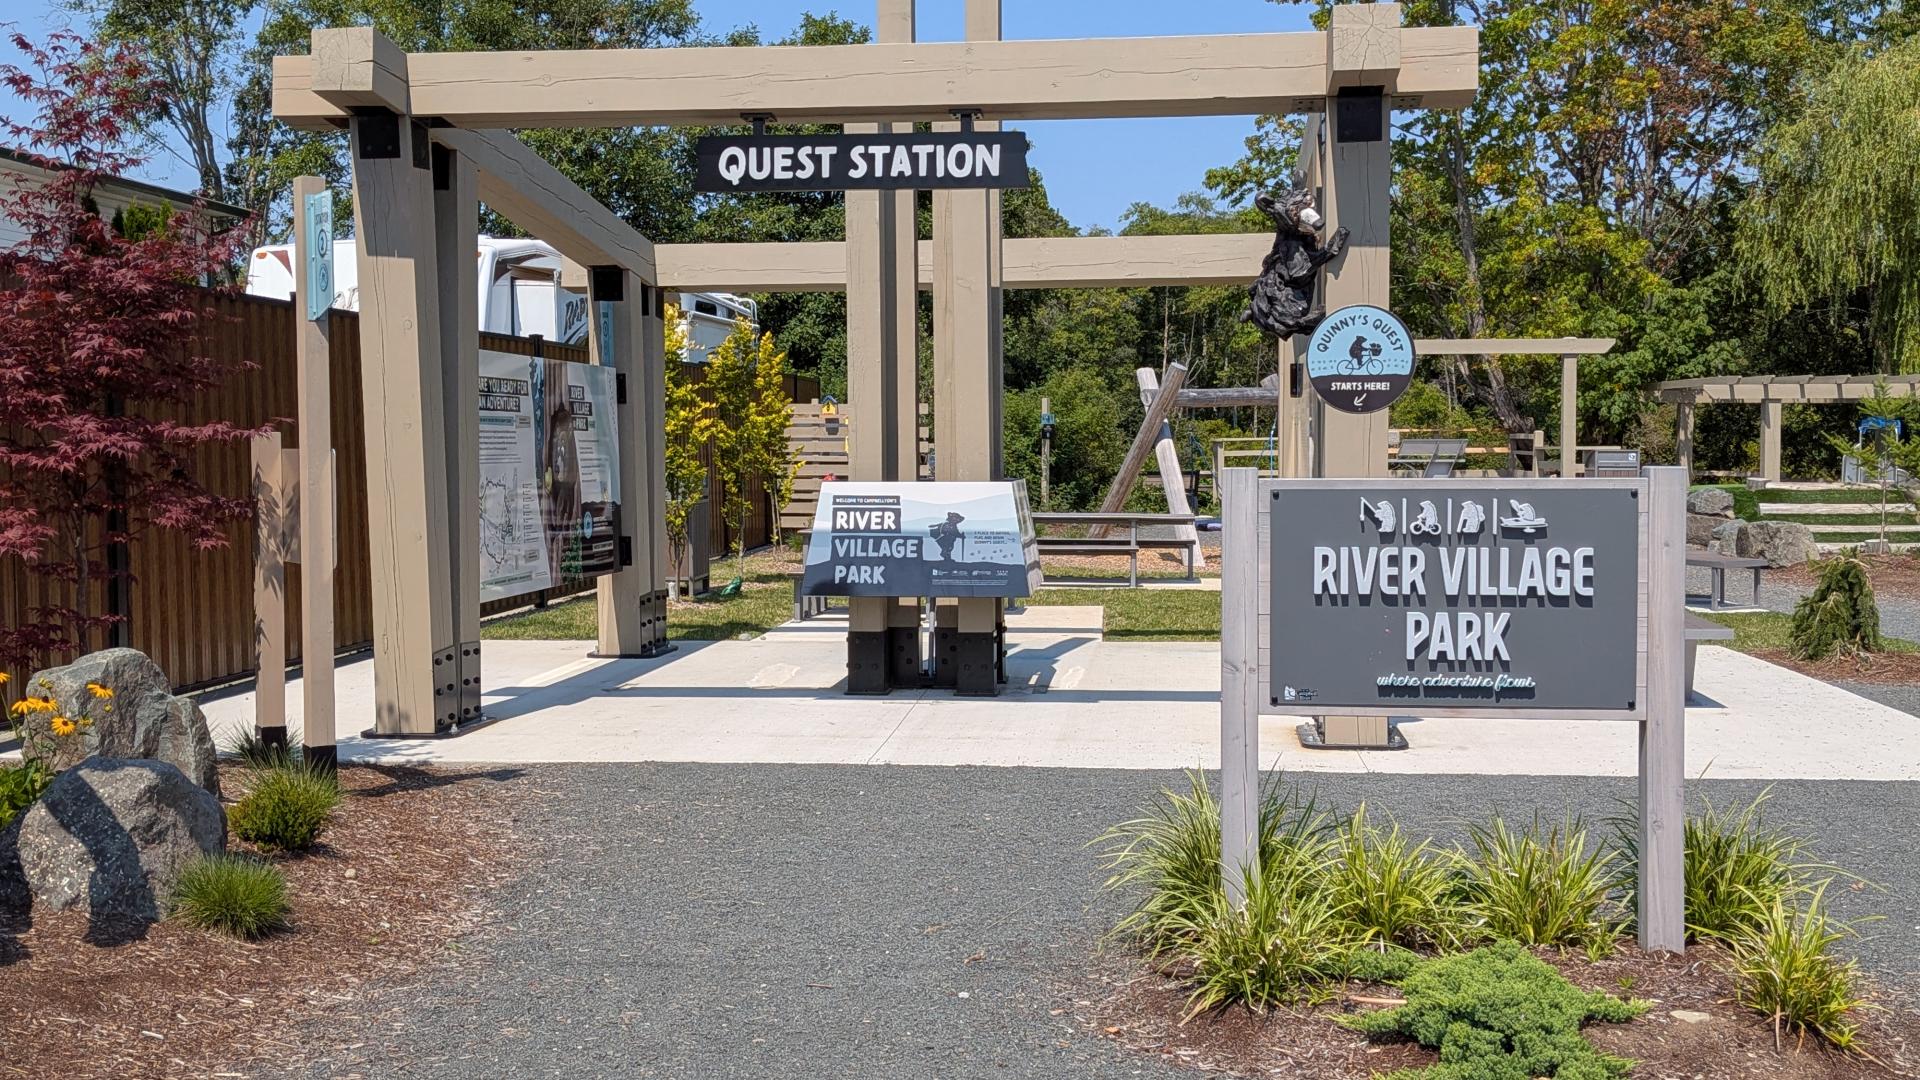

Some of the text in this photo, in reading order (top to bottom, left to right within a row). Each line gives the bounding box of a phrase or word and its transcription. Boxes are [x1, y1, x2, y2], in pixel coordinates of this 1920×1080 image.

[718, 143, 1001, 186] QUEST STATION
[1316, 314, 1404, 353] QUINNY'S QUEST
[489, 378, 501, 393] YOU
[518, 380, 528, 395] FOR
[1330, 381, 1390, 391] STARTS HERE!
[487, 395, 520, 411] ADVENTURE?
[835, 510, 897, 531] RIVER
[834, 538, 919, 559] VILLAGE
[834, 564, 886, 585] PARK
[1313, 546, 1594, 596] RIVER VILLAGE
[1406, 611, 1511, 662] PARK
[1376, 673, 1536, 692] where adventure flows
